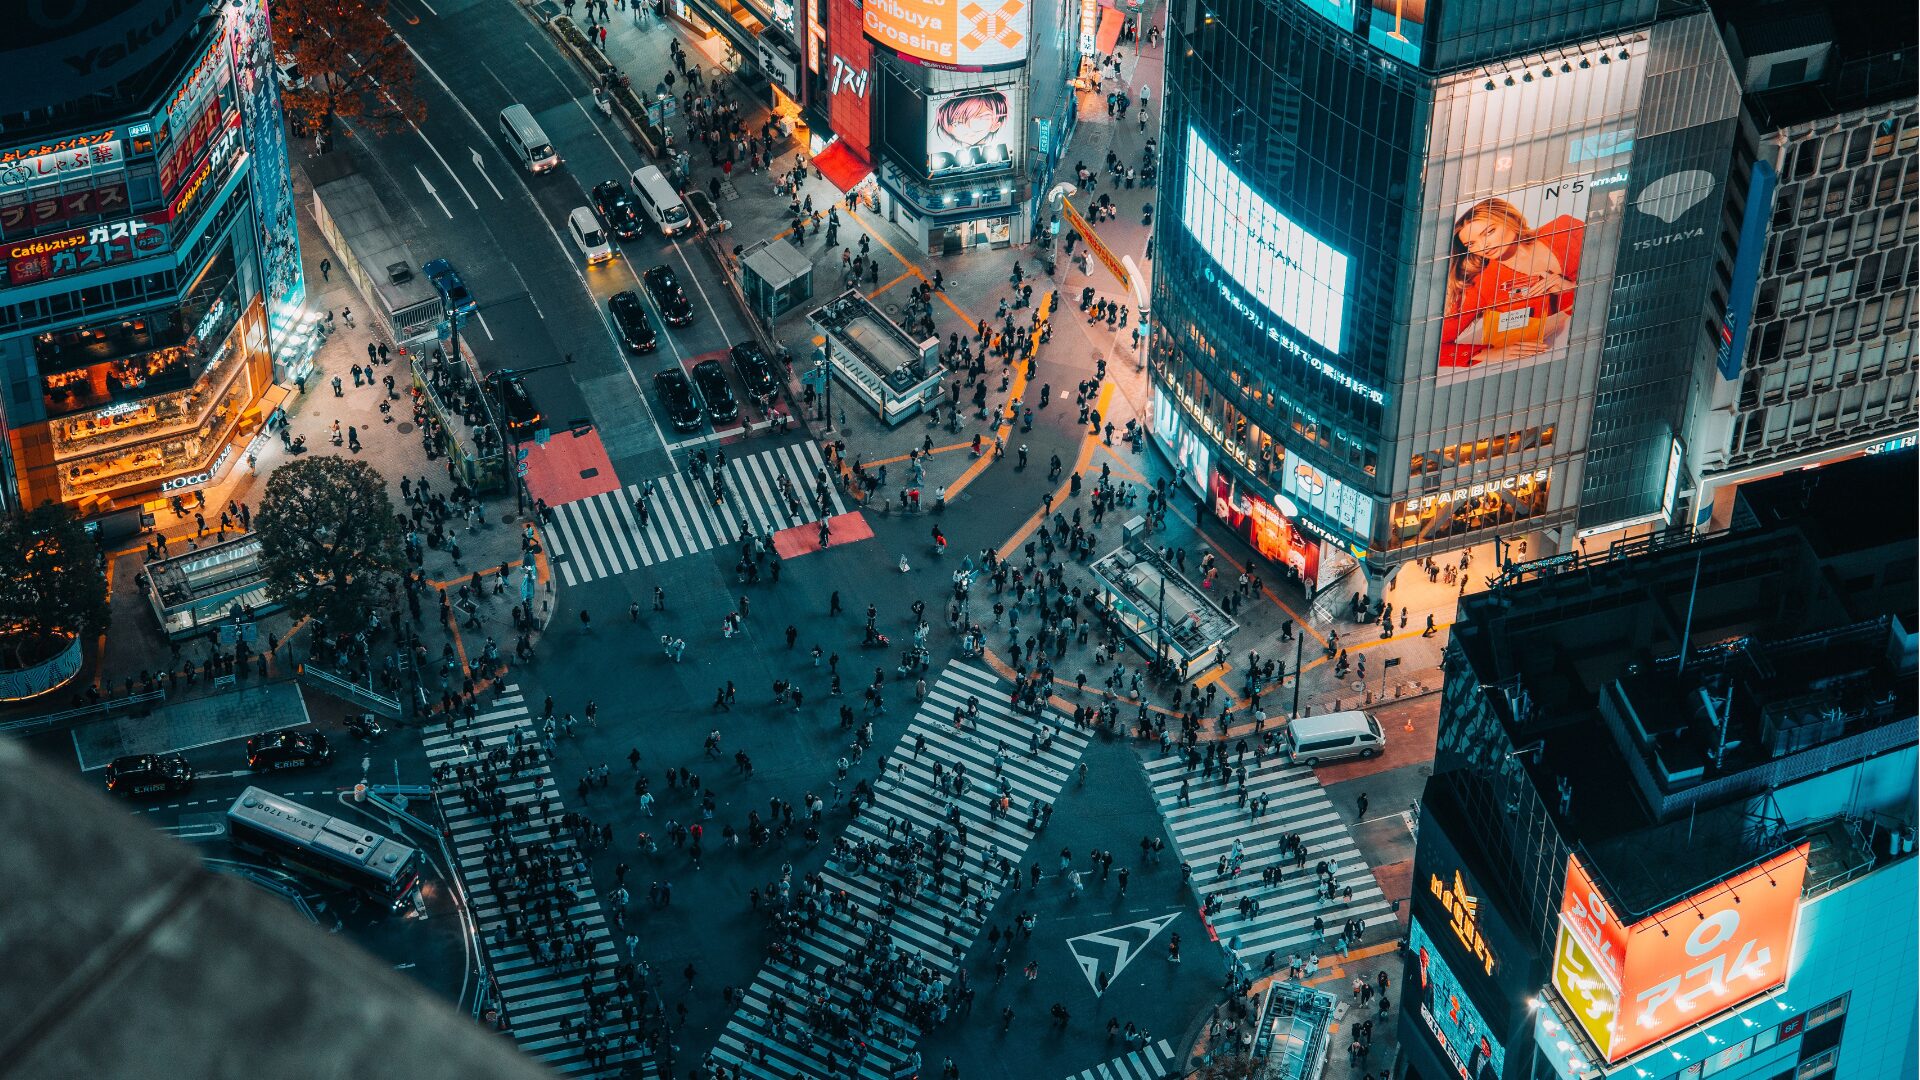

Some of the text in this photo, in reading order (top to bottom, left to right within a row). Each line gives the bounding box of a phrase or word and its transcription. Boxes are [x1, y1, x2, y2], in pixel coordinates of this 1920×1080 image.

[865, 11, 953, 57] Crossing
[211, 126, 238, 172] ガスト
[1, 187, 124, 228] プライス
[89, 220, 148, 245] ガスト
[1248, 229, 1298, 271] JAPAN
[1633, 227, 1706, 251] TSUTAYA
[52, 243, 125, 273] ガスト
[1168, 372, 1257, 473] STARBUCKS
[1406, 469, 1547, 512] STARBUCKS
[1301, 517, 1346, 549] TSUTAYA
[256, 803, 283, 819] 1700
[1572, 890, 1617, 974] アコム
[1635, 937, 1771, 1028] アコム
[1784, 1021, 1799, 1035] 8F
